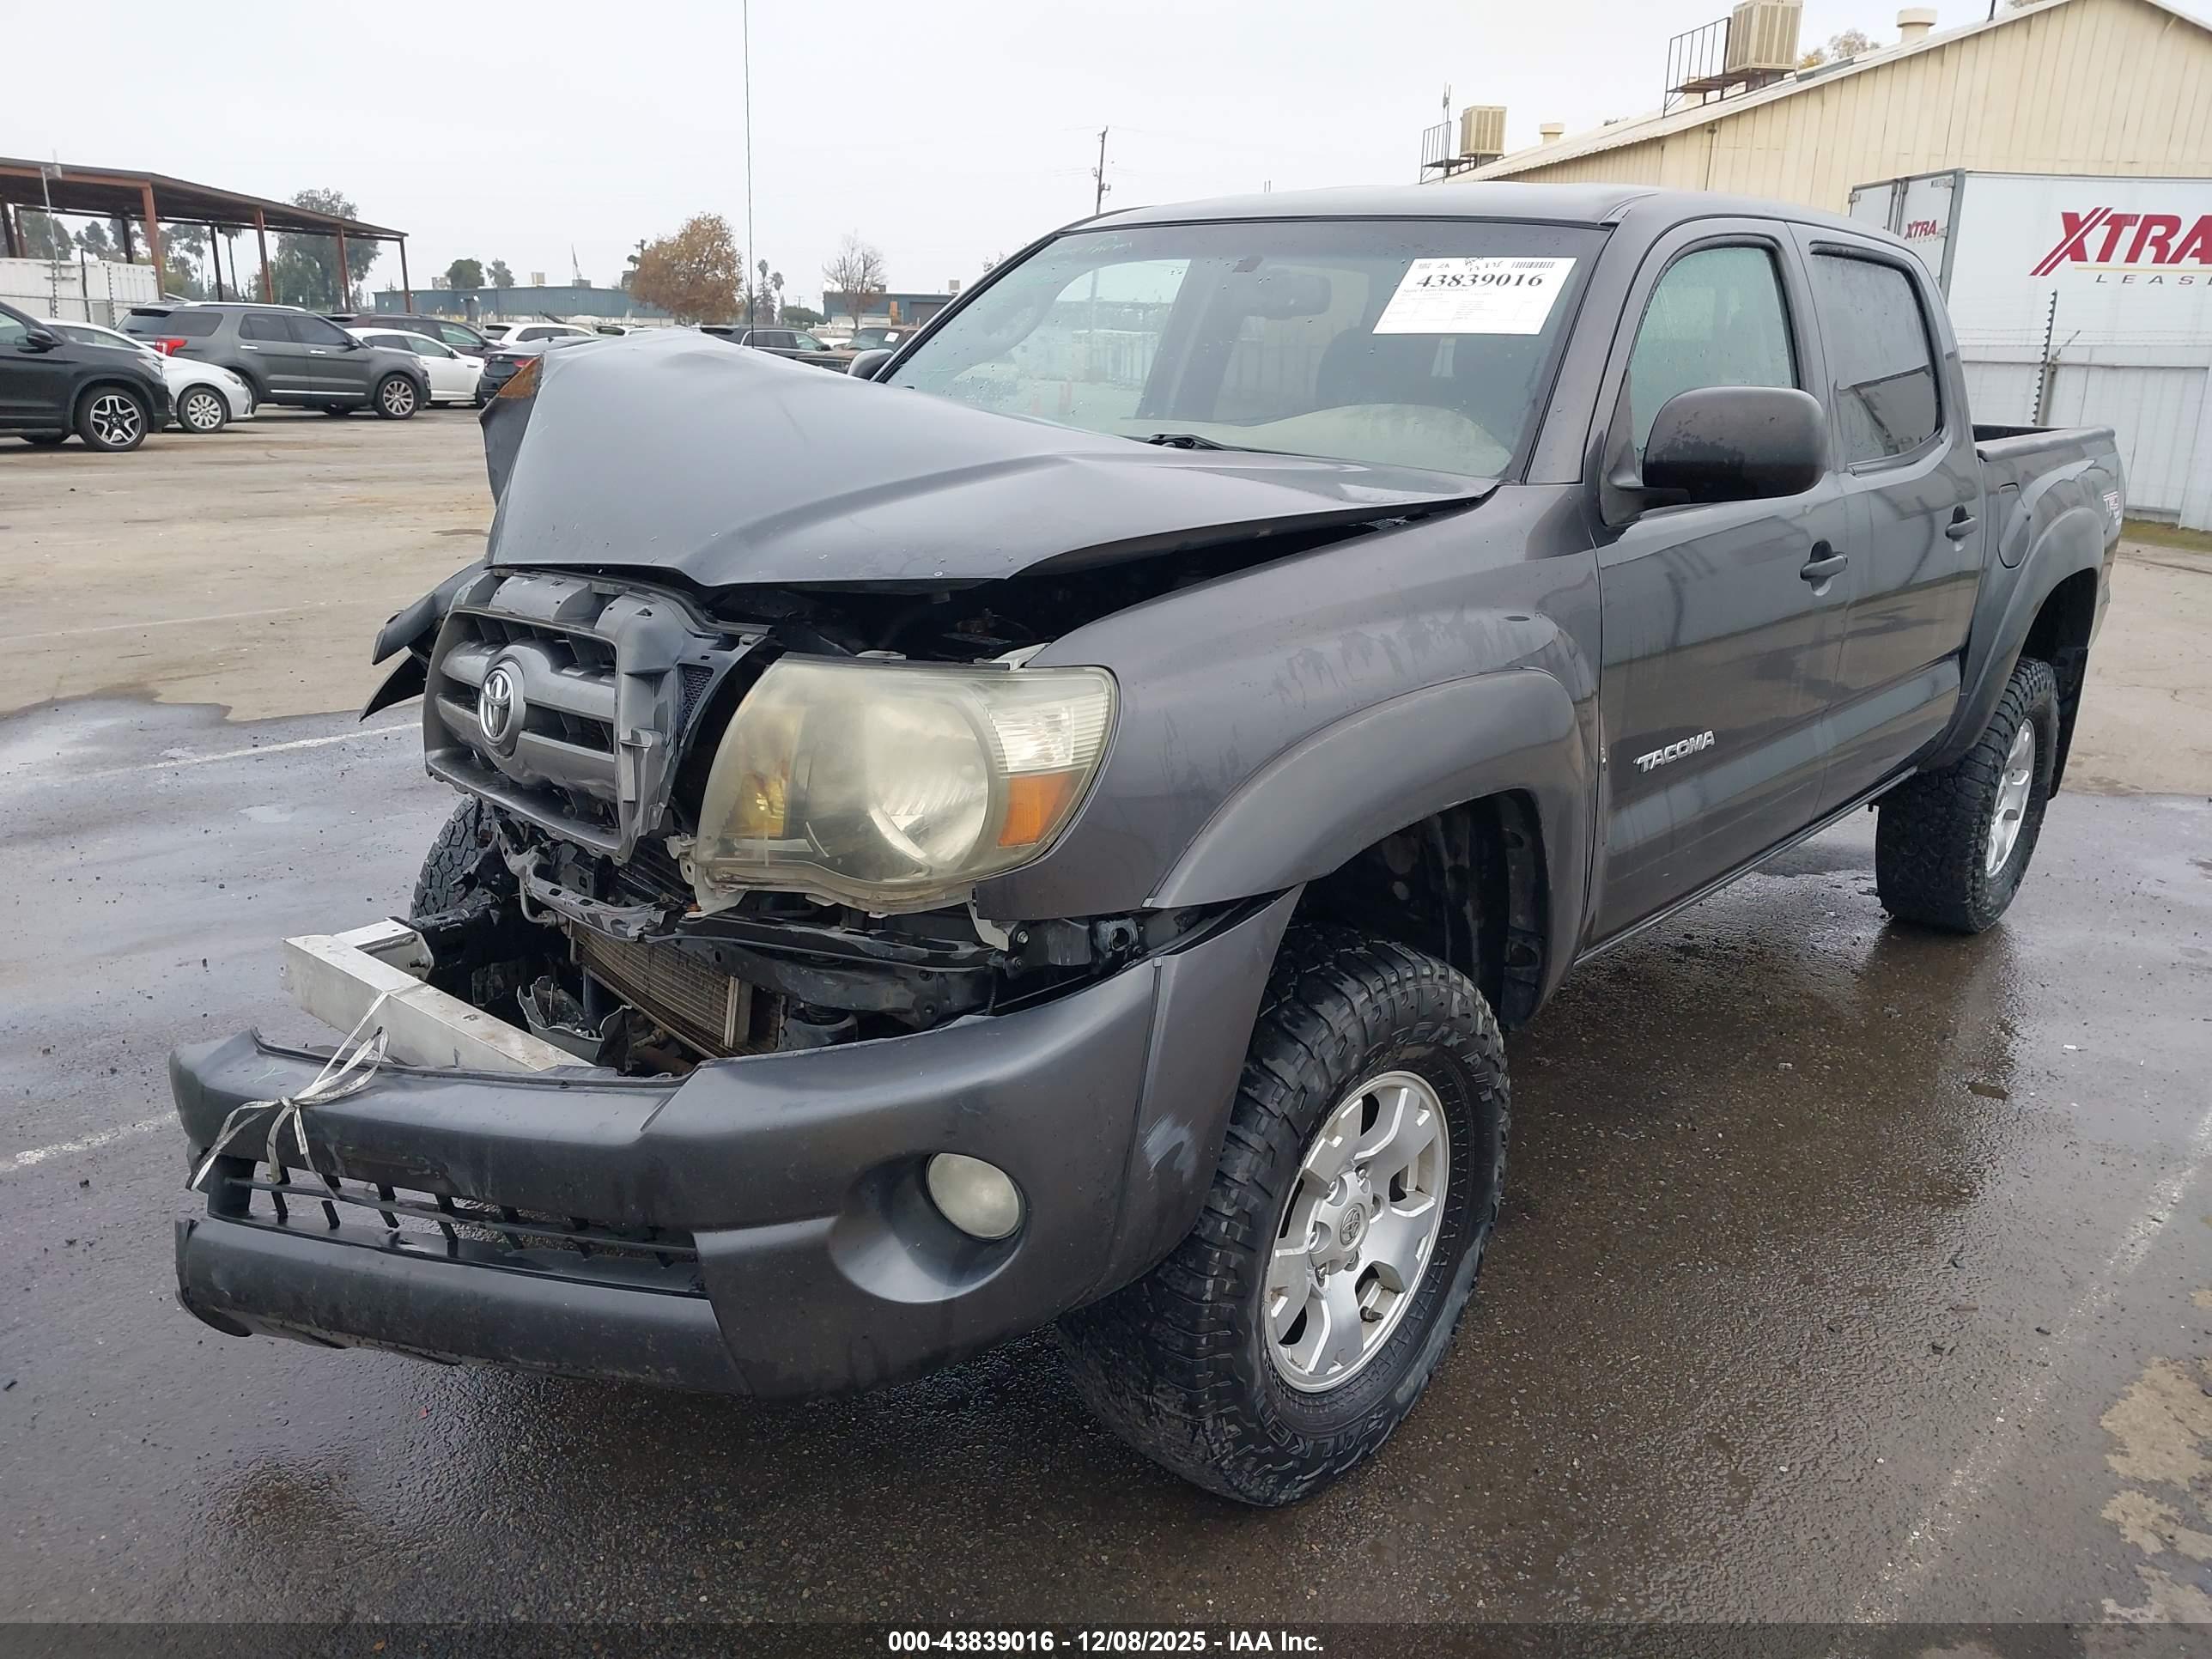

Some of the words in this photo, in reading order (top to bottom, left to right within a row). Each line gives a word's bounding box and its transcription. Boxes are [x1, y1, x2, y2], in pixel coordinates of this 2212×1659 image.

[1904, 220, 1937, 240] XTRA
[2029, 206, 2212, 276] XTRA
[1417, 273, 1545, 289] 43839016
[1632, 730, 1715, 773] TACOMA
